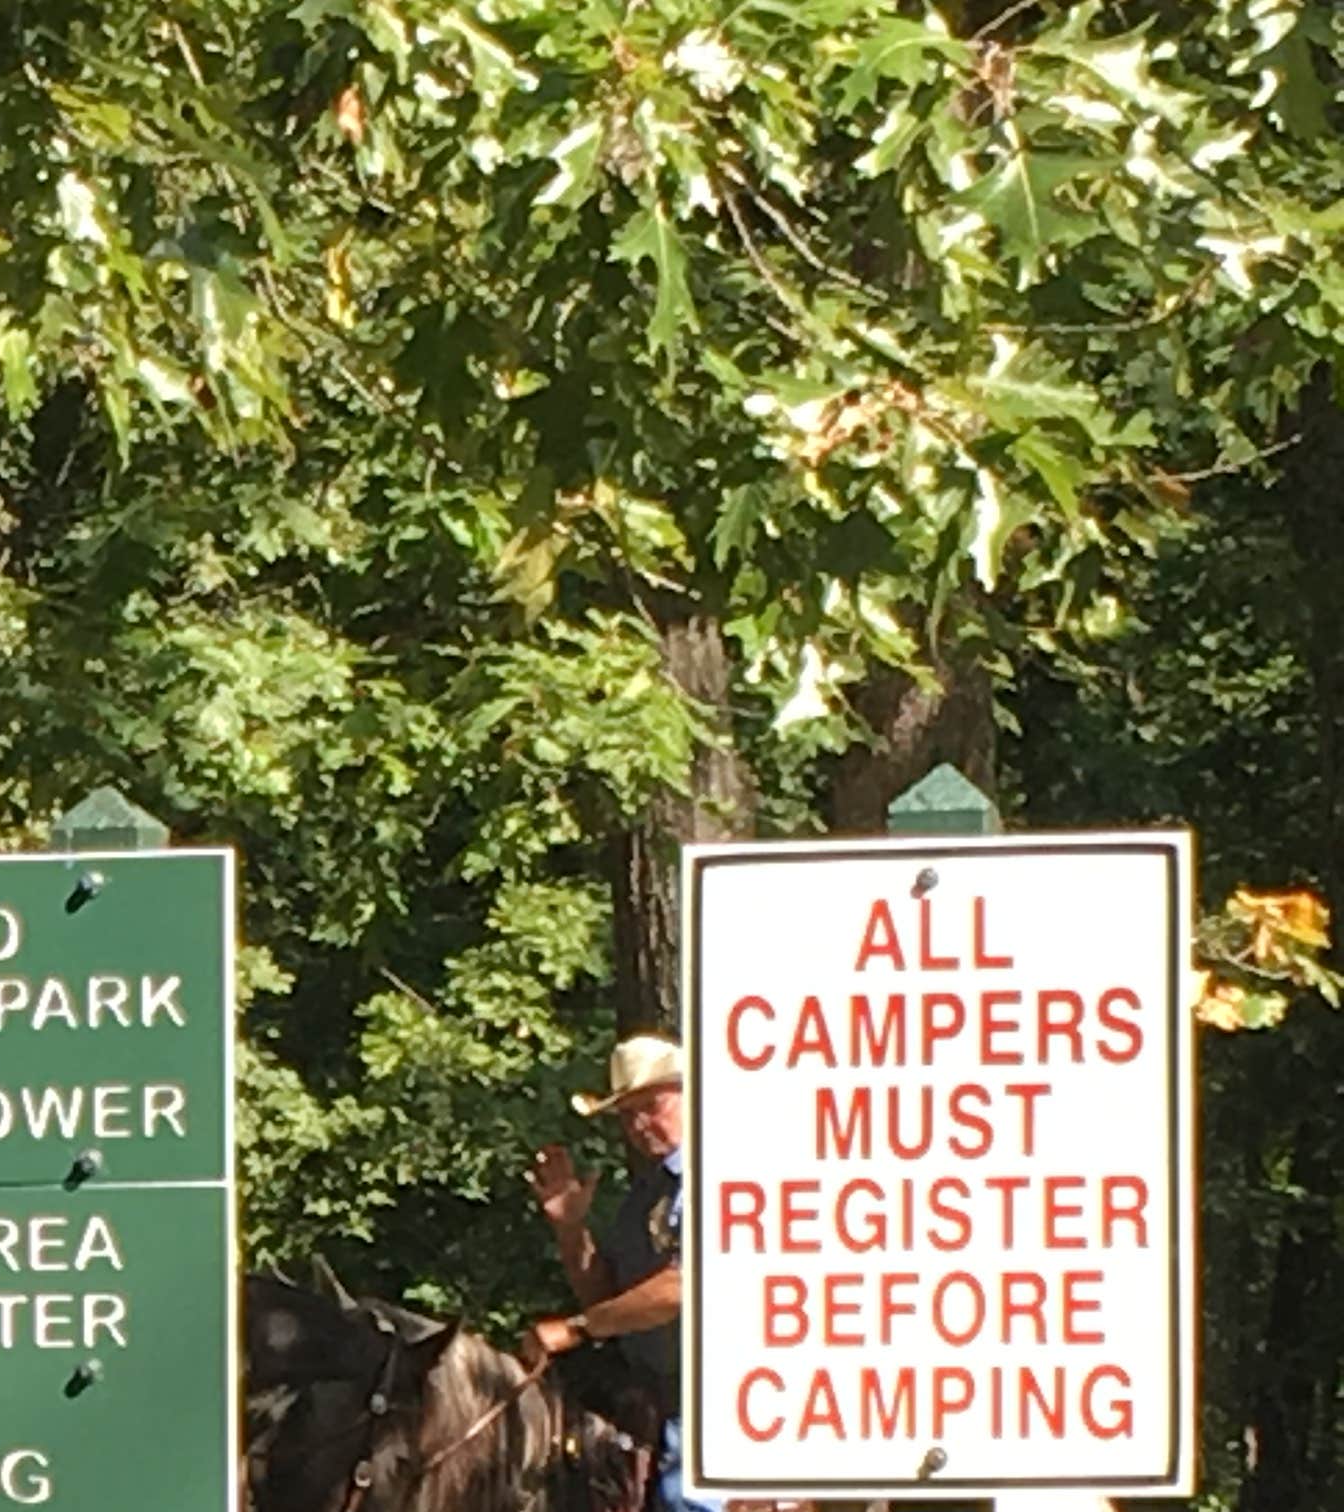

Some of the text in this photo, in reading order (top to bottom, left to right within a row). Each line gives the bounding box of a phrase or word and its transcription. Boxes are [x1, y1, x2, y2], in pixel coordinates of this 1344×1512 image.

[854, 895, 1014, 972] ALL
[725, 987, 1145, 1072] CAMPERS
[815, 1082, 1052, 1160] MUST
[719, 1175, 1149, 1253] REGISTER
[763, 1270, 1105, 1348] BEFORE
[736, 1364, 1134, 1442] CAMPING
